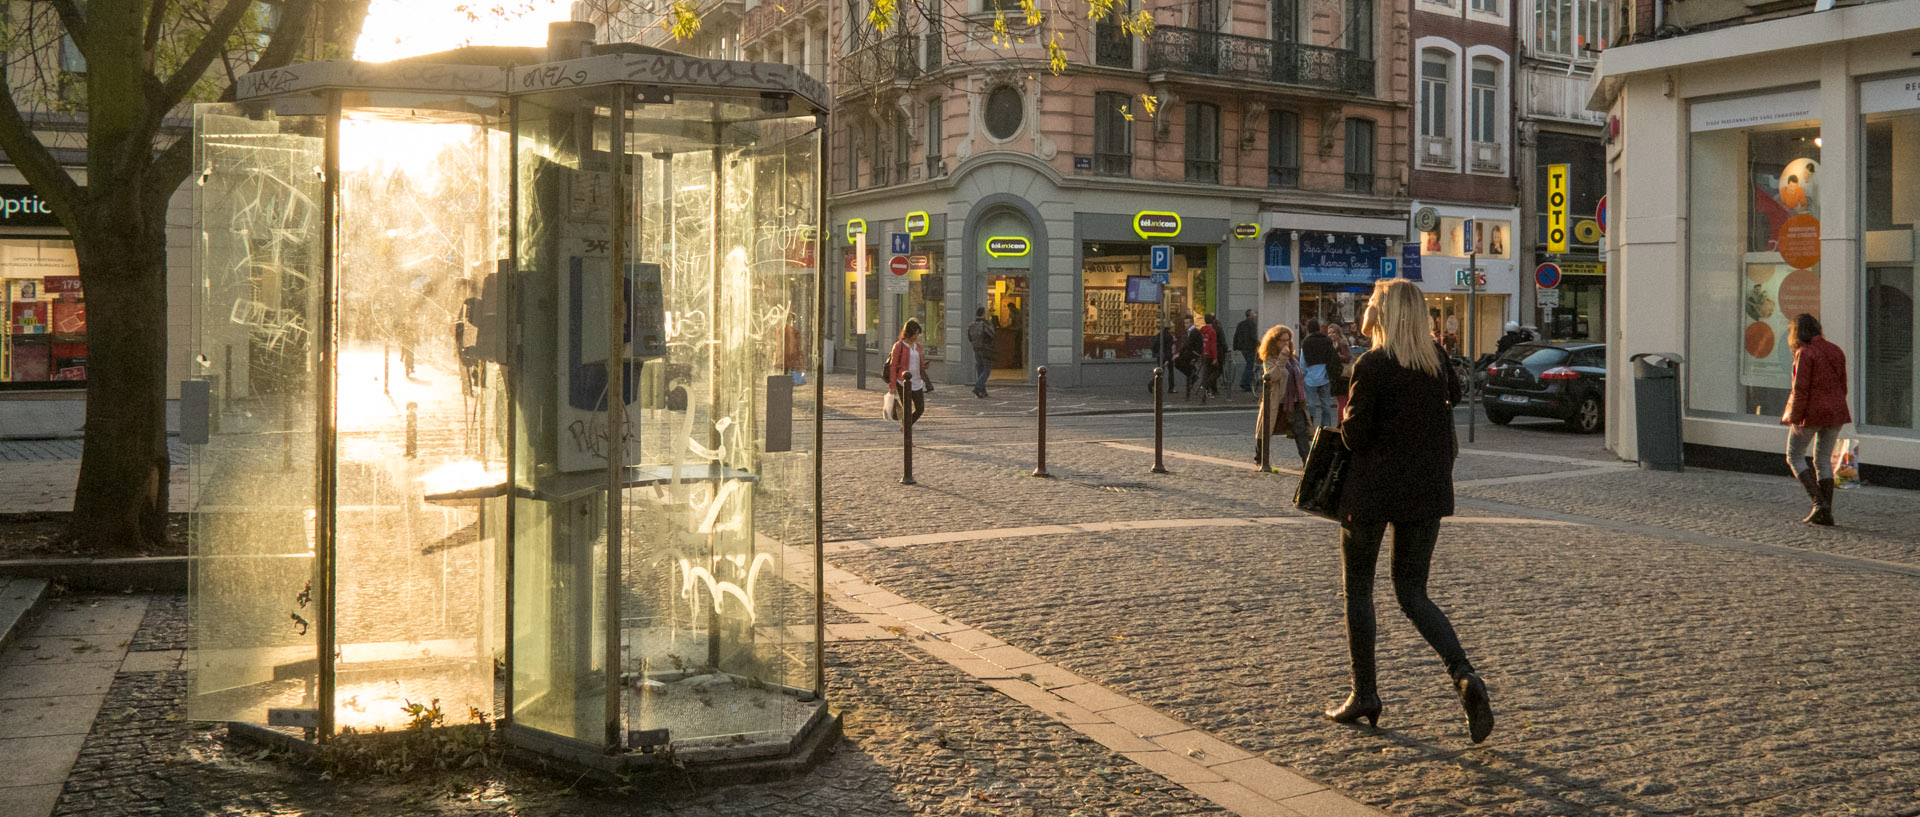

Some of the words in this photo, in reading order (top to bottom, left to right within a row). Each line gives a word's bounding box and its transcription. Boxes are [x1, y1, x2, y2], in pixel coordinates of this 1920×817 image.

[1774, 110, 1810, 119] ENGAGEMENT
[1550, 174, 1564, 244] TOTO
[1140, 219, 1177, 228] télandcom
[1303, 241, 1322, 258] Papa
[1156, 250, 1165, 266] P
[1385, 262, 1393, 275] P
[62, 280, 80, 289] 179
